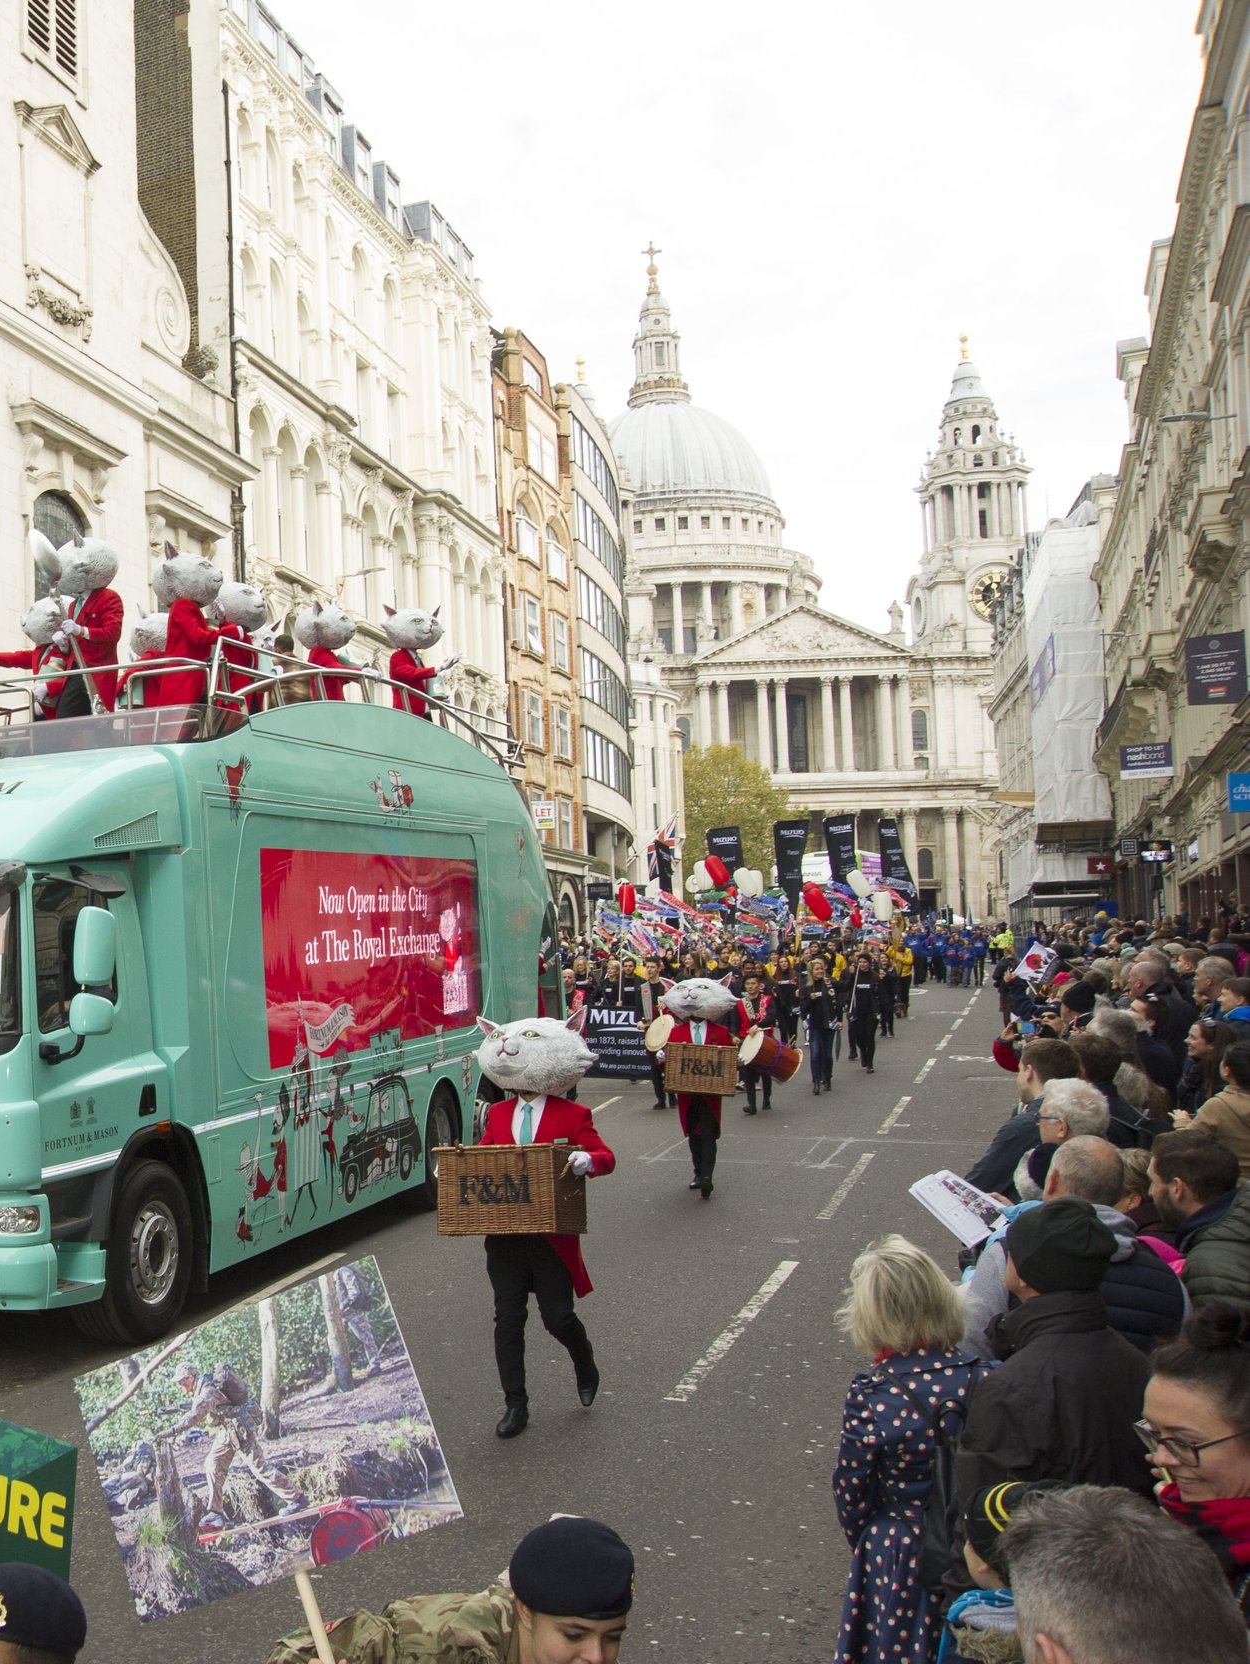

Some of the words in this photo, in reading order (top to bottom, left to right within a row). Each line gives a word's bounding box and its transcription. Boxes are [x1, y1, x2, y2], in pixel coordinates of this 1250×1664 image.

[1126, 750, 1165, 761] nashbond
[535, 808, 552, 817] LET
[318, 886, 345, 914] Now
[347, 886, 376, 920] Open
[378, 888, 389, 912] in
[391, 886, 407, 912] the
[408, 886, 428, 918] City
[305, 937, 320, 965] at
[322, 929, 350, 963] The
[352, 926, 387, 967] Royal
[388, 926, 441, 960] Exchange
[599, 1036, 617, 1045] 1873,
[618, 1037, 639, 1045] raised
[591, 1047, 621, 1056] providing
[679, 1057, 724, 1077] F&M
[44, 1133, 85, 1152] FORTNUM
[86, 1132, 93, 1142] &
[93, 1125, 119, 1141] MASON
[458, 1173, 533, 1204] F&M
